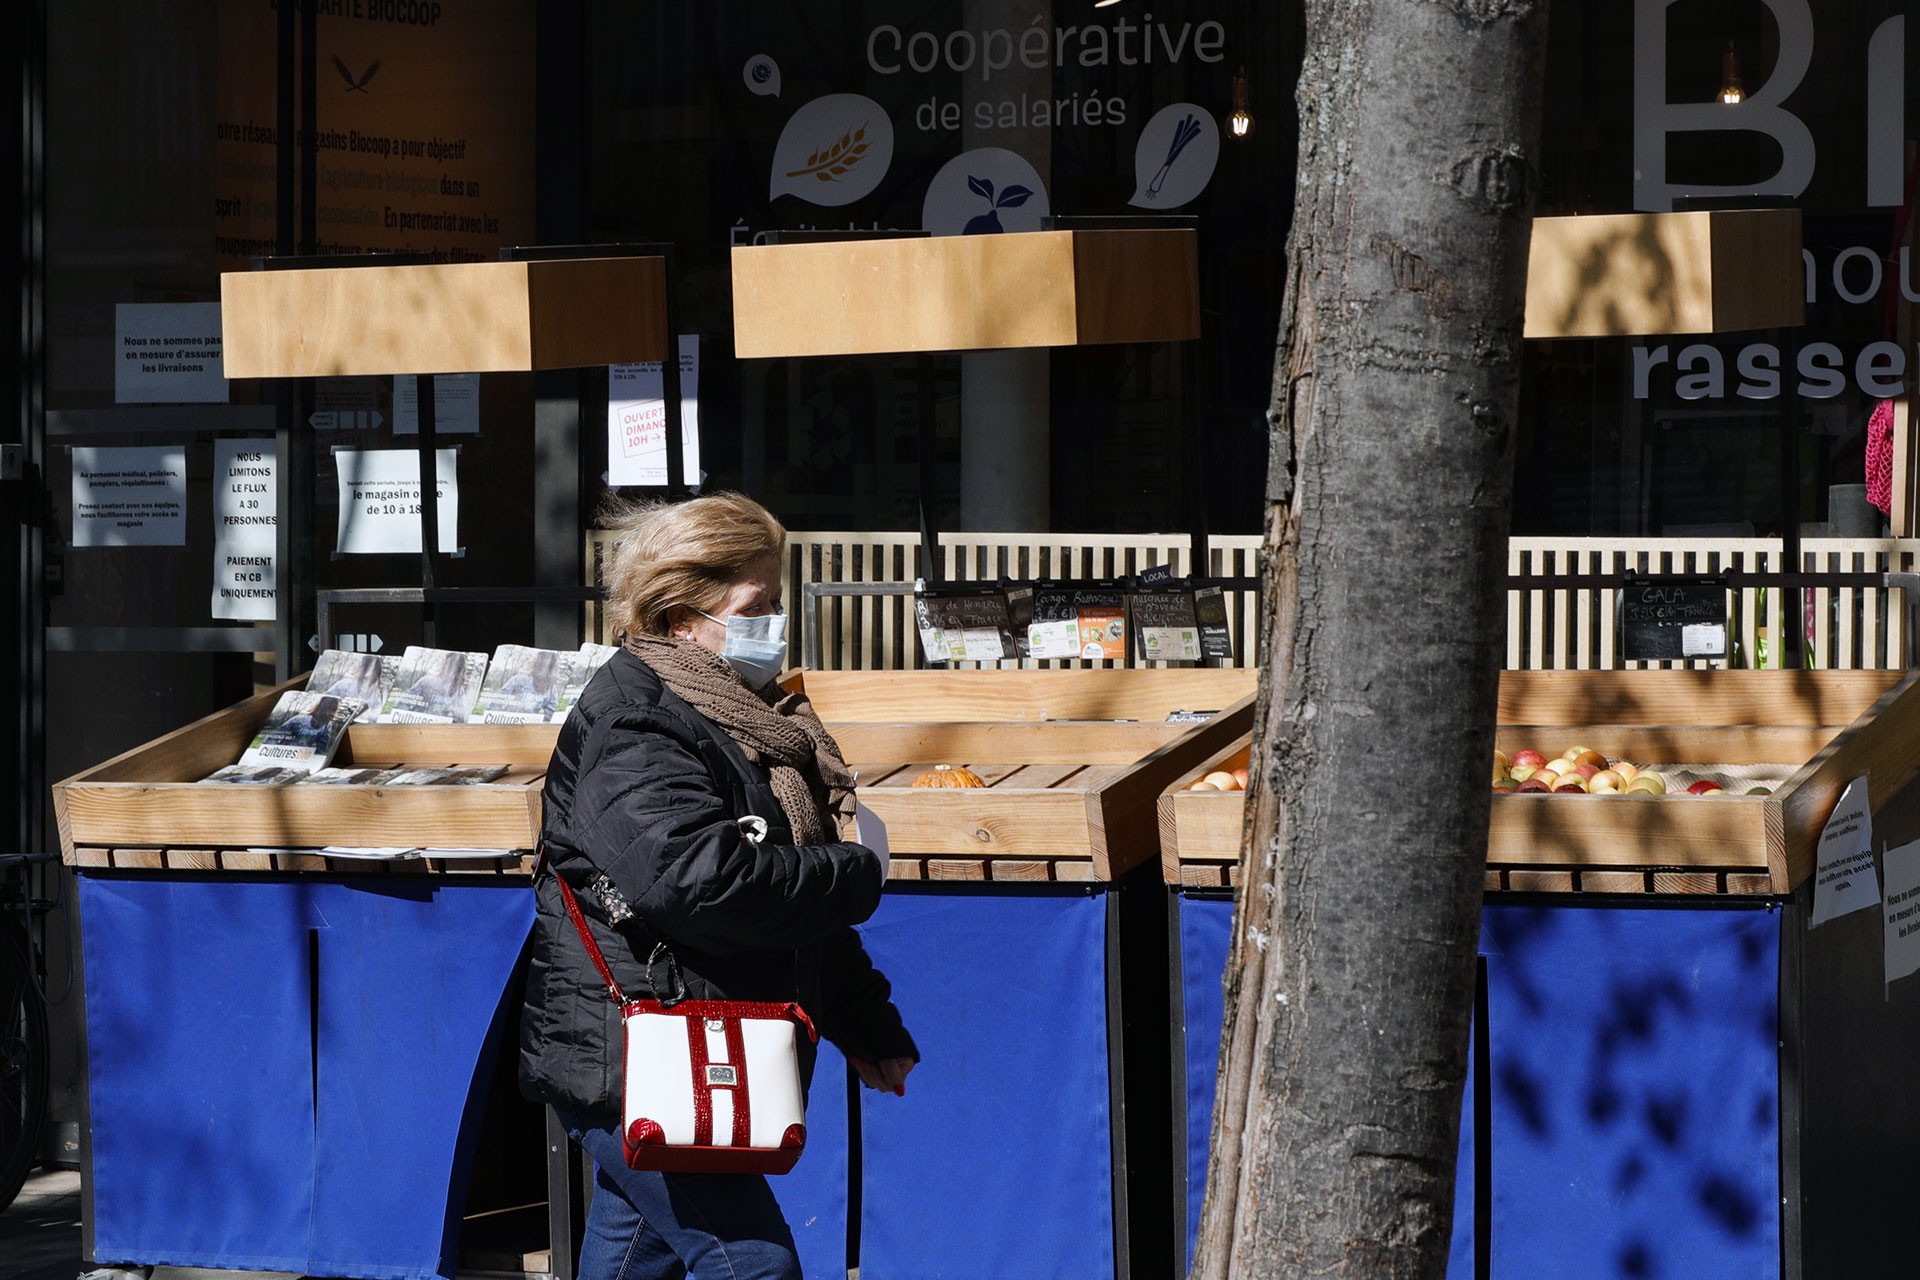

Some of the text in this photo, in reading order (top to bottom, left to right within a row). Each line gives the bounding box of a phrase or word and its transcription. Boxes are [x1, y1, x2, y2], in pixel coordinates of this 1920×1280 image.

[367, 0, 441, 26] BIOCOOP
[866, 13, 1226, 81] Coopérative
[916, 89, 1127, 131] de salariés
[217, 121, 240, 141] otre
[350, 130, 391, 159] Biocoop
[392, 142, 399, 154] a
[401, 139, 426, 161] pour
[427, 138, 466, 163] objectif
[440, 174, 464, 197] dans
[466, 180, 479, 198] un
[216, 196, 241, 219] sprit
[384, 206, 398, 228] En
[399, 211, 456, 233] partenariat
[458, 215, 482, 234] avec
[484, 212, 499, 234] les
[124, 337, 222, 346] Nous ne sommes pas
[125, 350, 220, 360] en mesure d'assurer
[142, 363, 204, 373] les livraisons
[623, 406, 665, 424] OUVERT
[626, 419, 667, 436] DIMANC
[627, 434, 648, 448] 10H
[237, 452, 261, 462] NOUS
[148, 470, 178, 478] policiers,
[229, 467, 271, 477] LIMITONS
[232, 484, 267, 493] LE FLUX
[353, 490, 363, 500] le
[365, 489, 410, 502] magasin
[239, 499, 259, 509] A 30
[367, 505, 380, 515] de
[383, 504, 396, 515] 10
[398, 503, 406, 515] à
[117, 520, 143, 528] magasin
[224, 516, 277, 525] PERSONNES
[227, 557, 272, 566] PAIEMENT
[235, 573, 262, 582] EN CB
[1143, 571, 1169, 584] LOCAL
[1641, 586, 1687, 604] GALA
